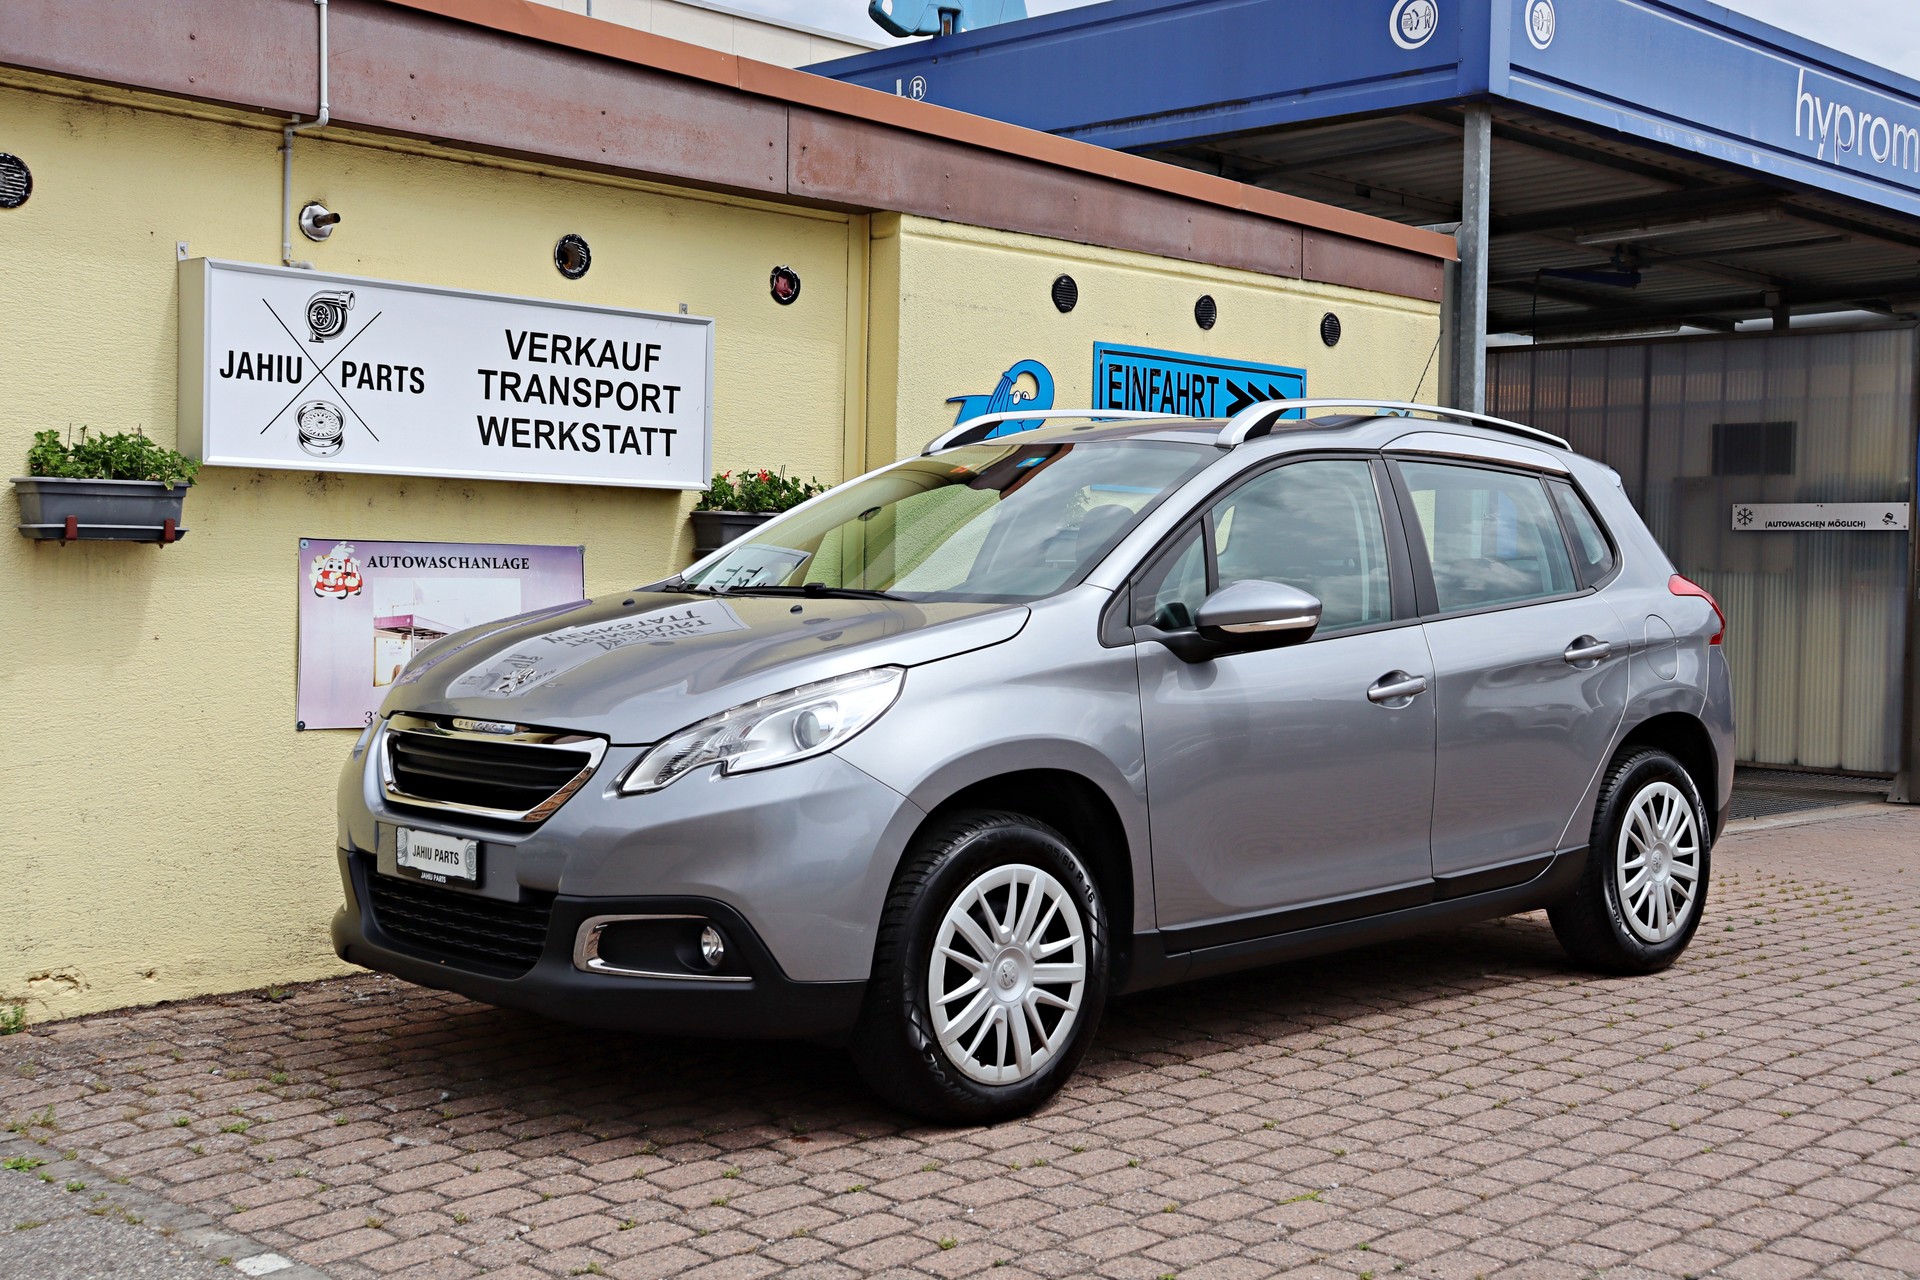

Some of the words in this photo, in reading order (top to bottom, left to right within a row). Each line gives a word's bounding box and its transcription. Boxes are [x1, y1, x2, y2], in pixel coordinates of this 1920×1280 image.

[219, 350, 303, 385] JAHIU
[341, 360, 425, 394] PARTS
[504, 328, 662, 373] VERKAUF
[477, 368, 681, 415] TRANSPORT
[1108, 363, 1220, 418] EINFAHRT
[476, 415, 678, 458] WERKSTATT
[1764, 520, 1826, 529] (AUTOWASCHEN
[1827, 519, 1866, 528] MÖGLICH)
[366, 555, 530, 570] AUTOWASCHANLAGE
[412, 844, 432, 861] JAHIU
[434, 848, 459, 865] PARTS
